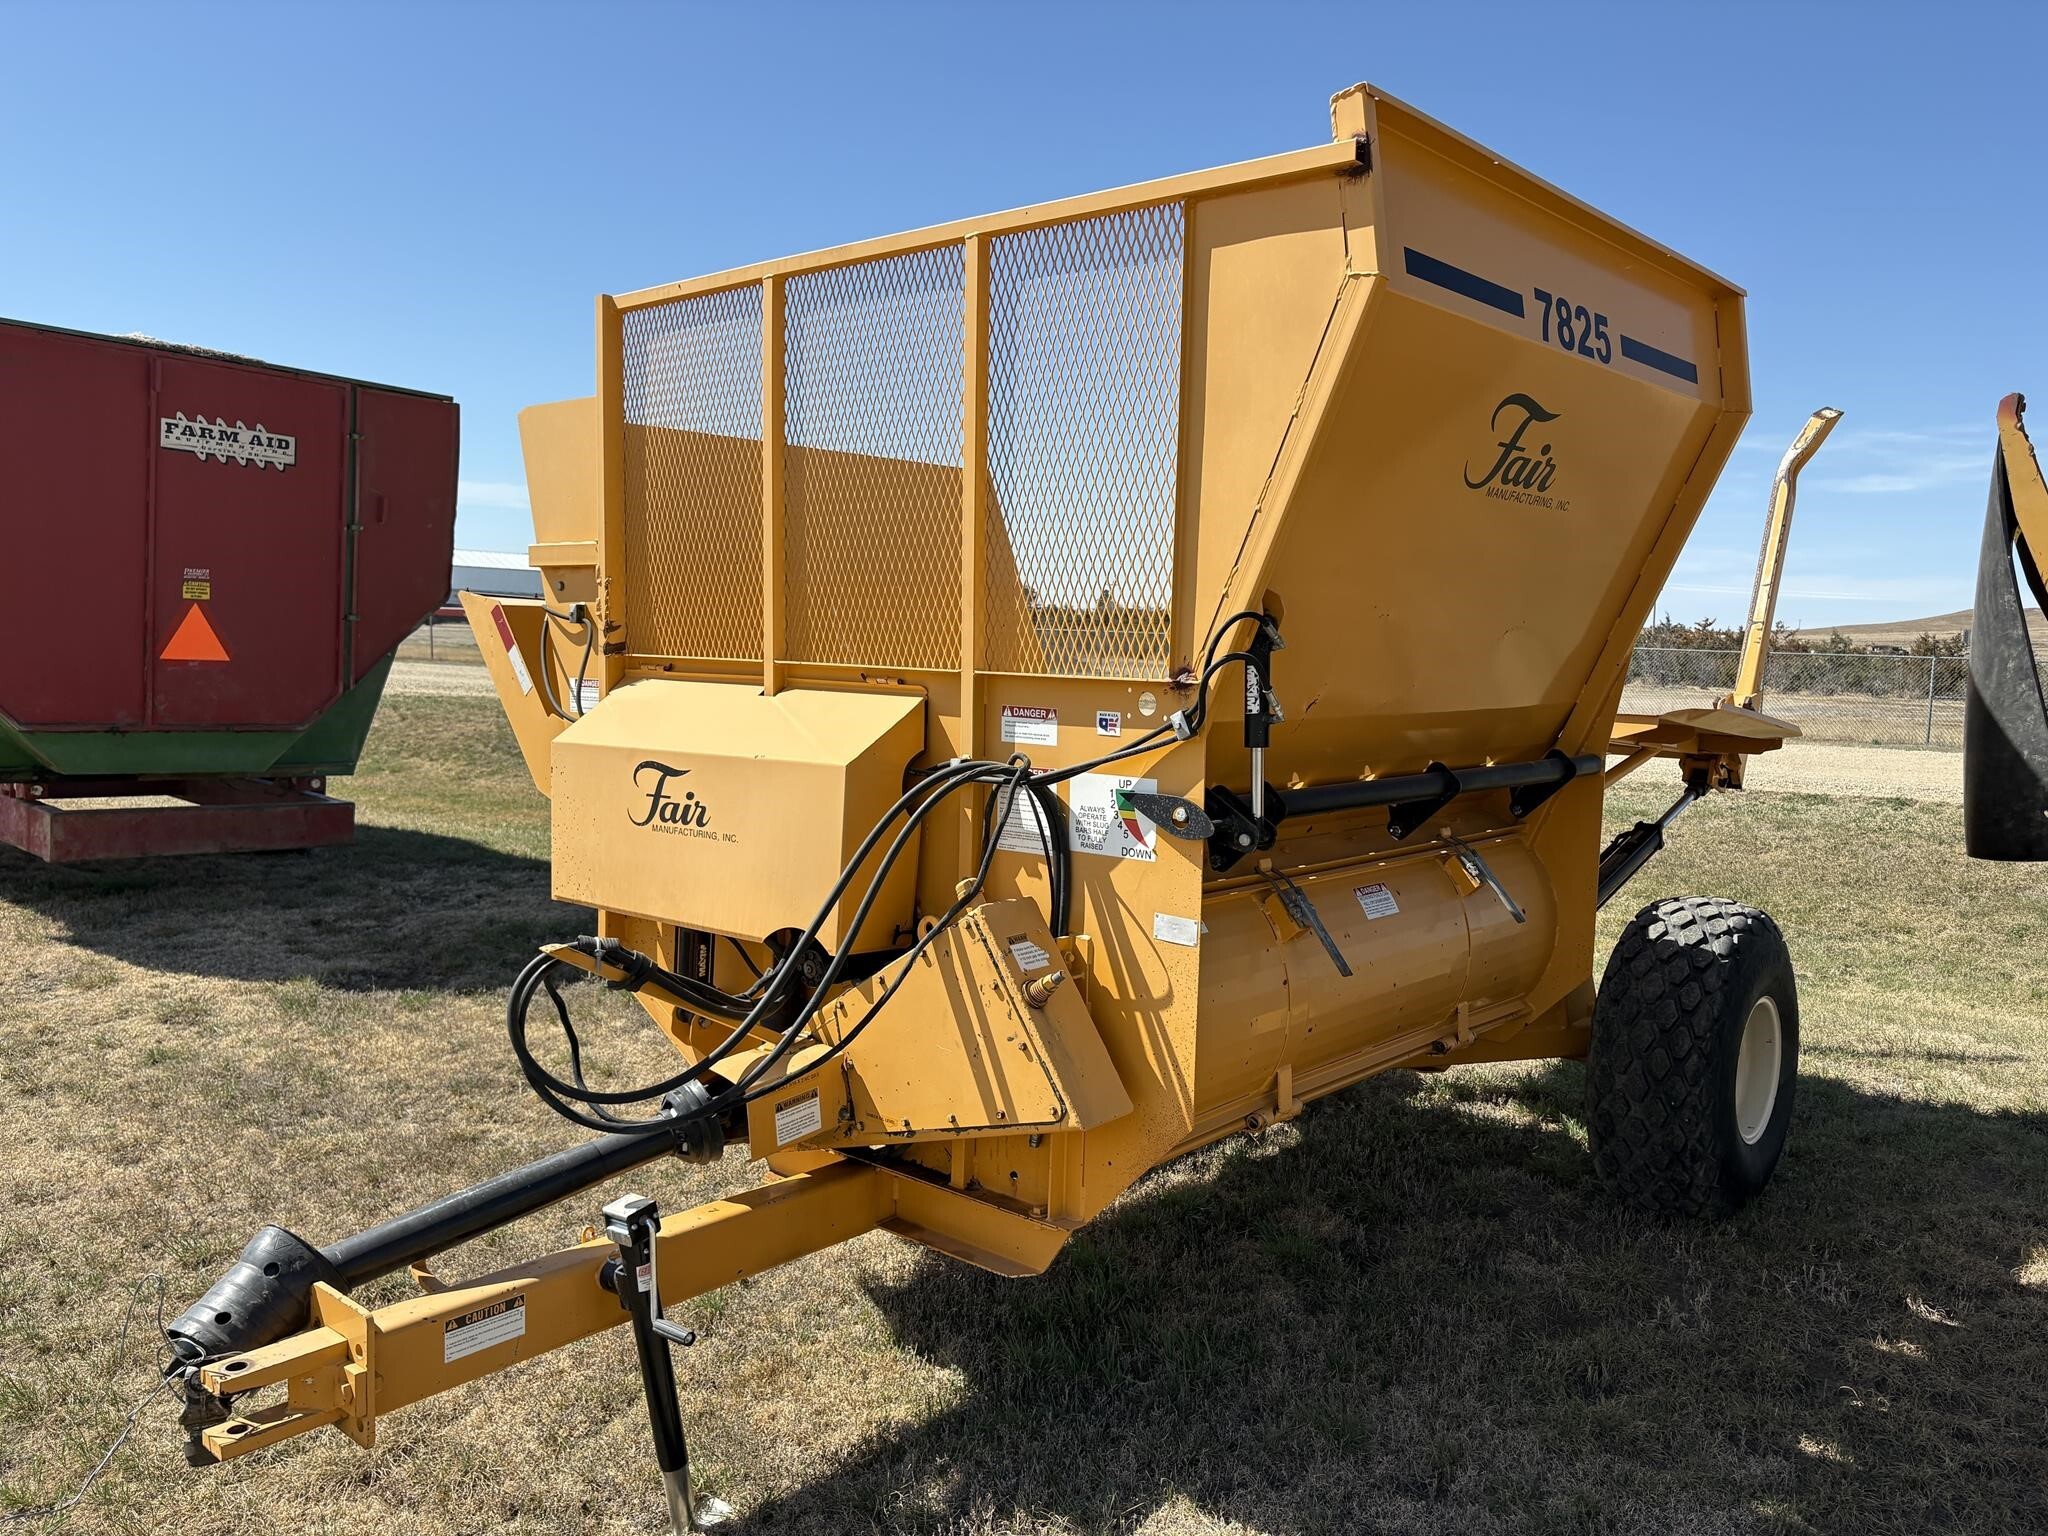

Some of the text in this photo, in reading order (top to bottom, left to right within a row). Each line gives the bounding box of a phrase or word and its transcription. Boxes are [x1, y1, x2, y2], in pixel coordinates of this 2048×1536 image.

[1533, 287, 1612, 365] 7825
[165, 421, 290, 450] FARM AID
[1464, 393, 1562, 493] Fair
[1485, 486, 1553, 510] MANUFACTURING,
[1013, 708, 1047, 719] DANGER
[1118, 779, 1133, 789] UP
[627, 760, 711, 828] Fair
[1110, 789, 1114, 798] 1
[1079, 805, 1106, 814] ALWAYS
[1110, 800, 1116, 809] 2
[1077, 811, 1107, 822] OPERATE
[1113, 810, 1119, 820] 3
[1075, 818, 1110, 830] WITH SLUG
[1117, 821, 1123, 830] 4
[652, 823, 740, 844] MANUFACTURING, INC.
[1075, 826, 1109, 836] BARS HALF
[1123, 829, 1129, 839] 5
[1087, 835, 1107, 844] FULLY
[1080, 841, 1104, 851] RAISED
[1121, 846, 1152, 860] DOWN
[783, 1094, 810, 1108] WARNING
[465, 1301, 507, 1325] CAUTION
